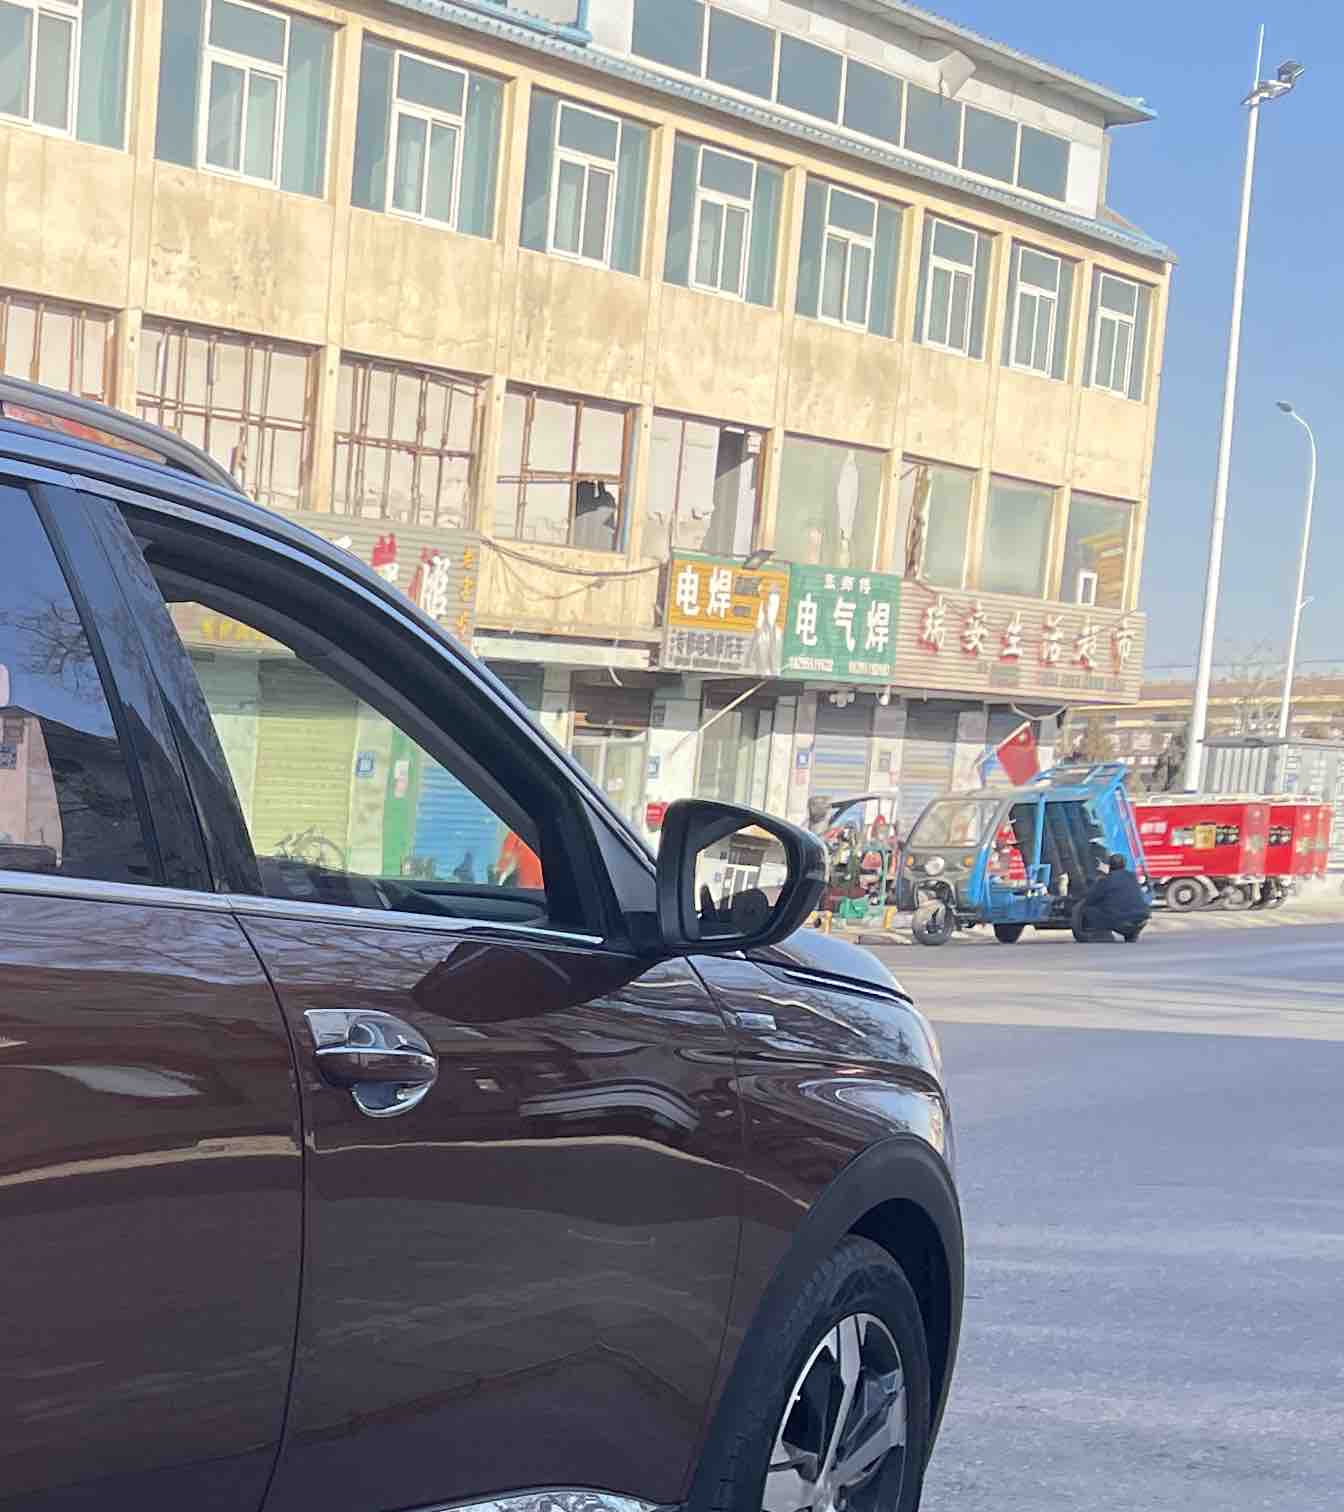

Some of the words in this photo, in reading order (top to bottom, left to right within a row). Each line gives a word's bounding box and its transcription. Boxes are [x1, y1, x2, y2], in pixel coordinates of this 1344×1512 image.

[676, 564, 733, 619] 电焊
[795, 592, 891, 653] 电气焊
